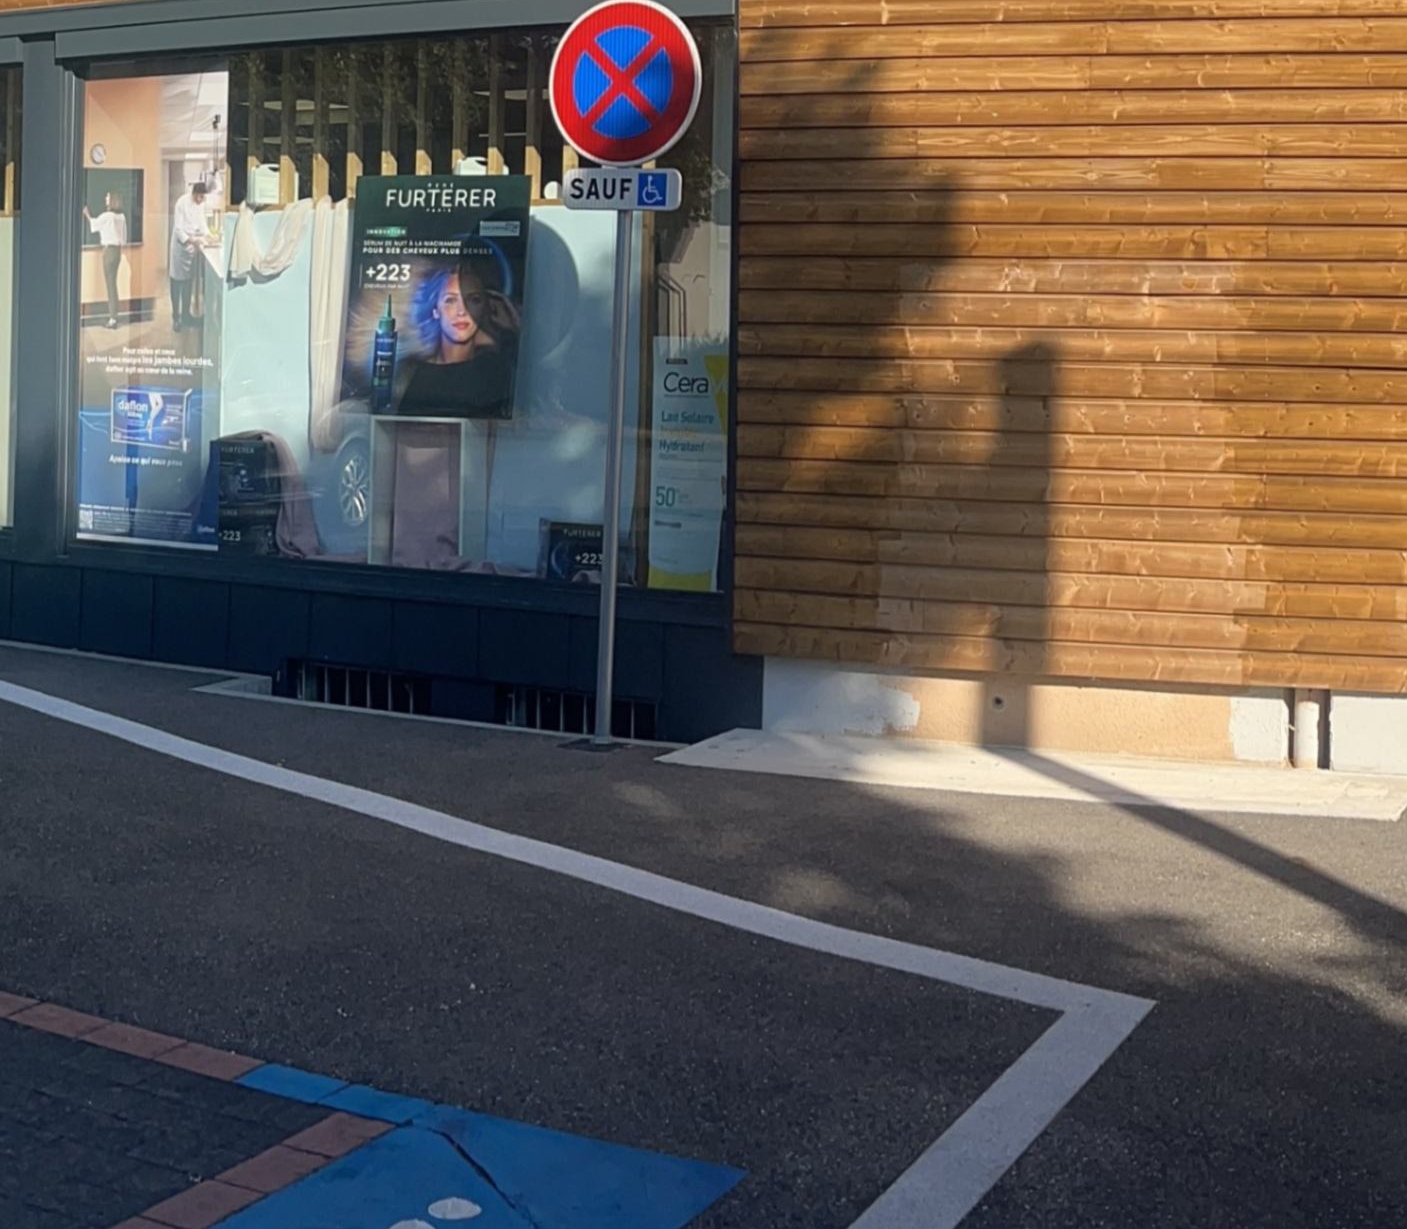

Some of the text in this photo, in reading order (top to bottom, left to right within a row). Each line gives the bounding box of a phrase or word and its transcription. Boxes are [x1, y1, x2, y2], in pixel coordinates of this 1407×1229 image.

[570, 178, 632, 201] SAUF
[385, 188, 497, 208] FURTERER
[365, 263, 411, 282] +223
[153, 355, 182, 367] jambes
[183, 356, 214, 367] lourdes,
[118, 400, 148, 414] daflon
[661, 410, 714, 424] Lait Solaire
[659, 439, 705, 453] Hydratant
